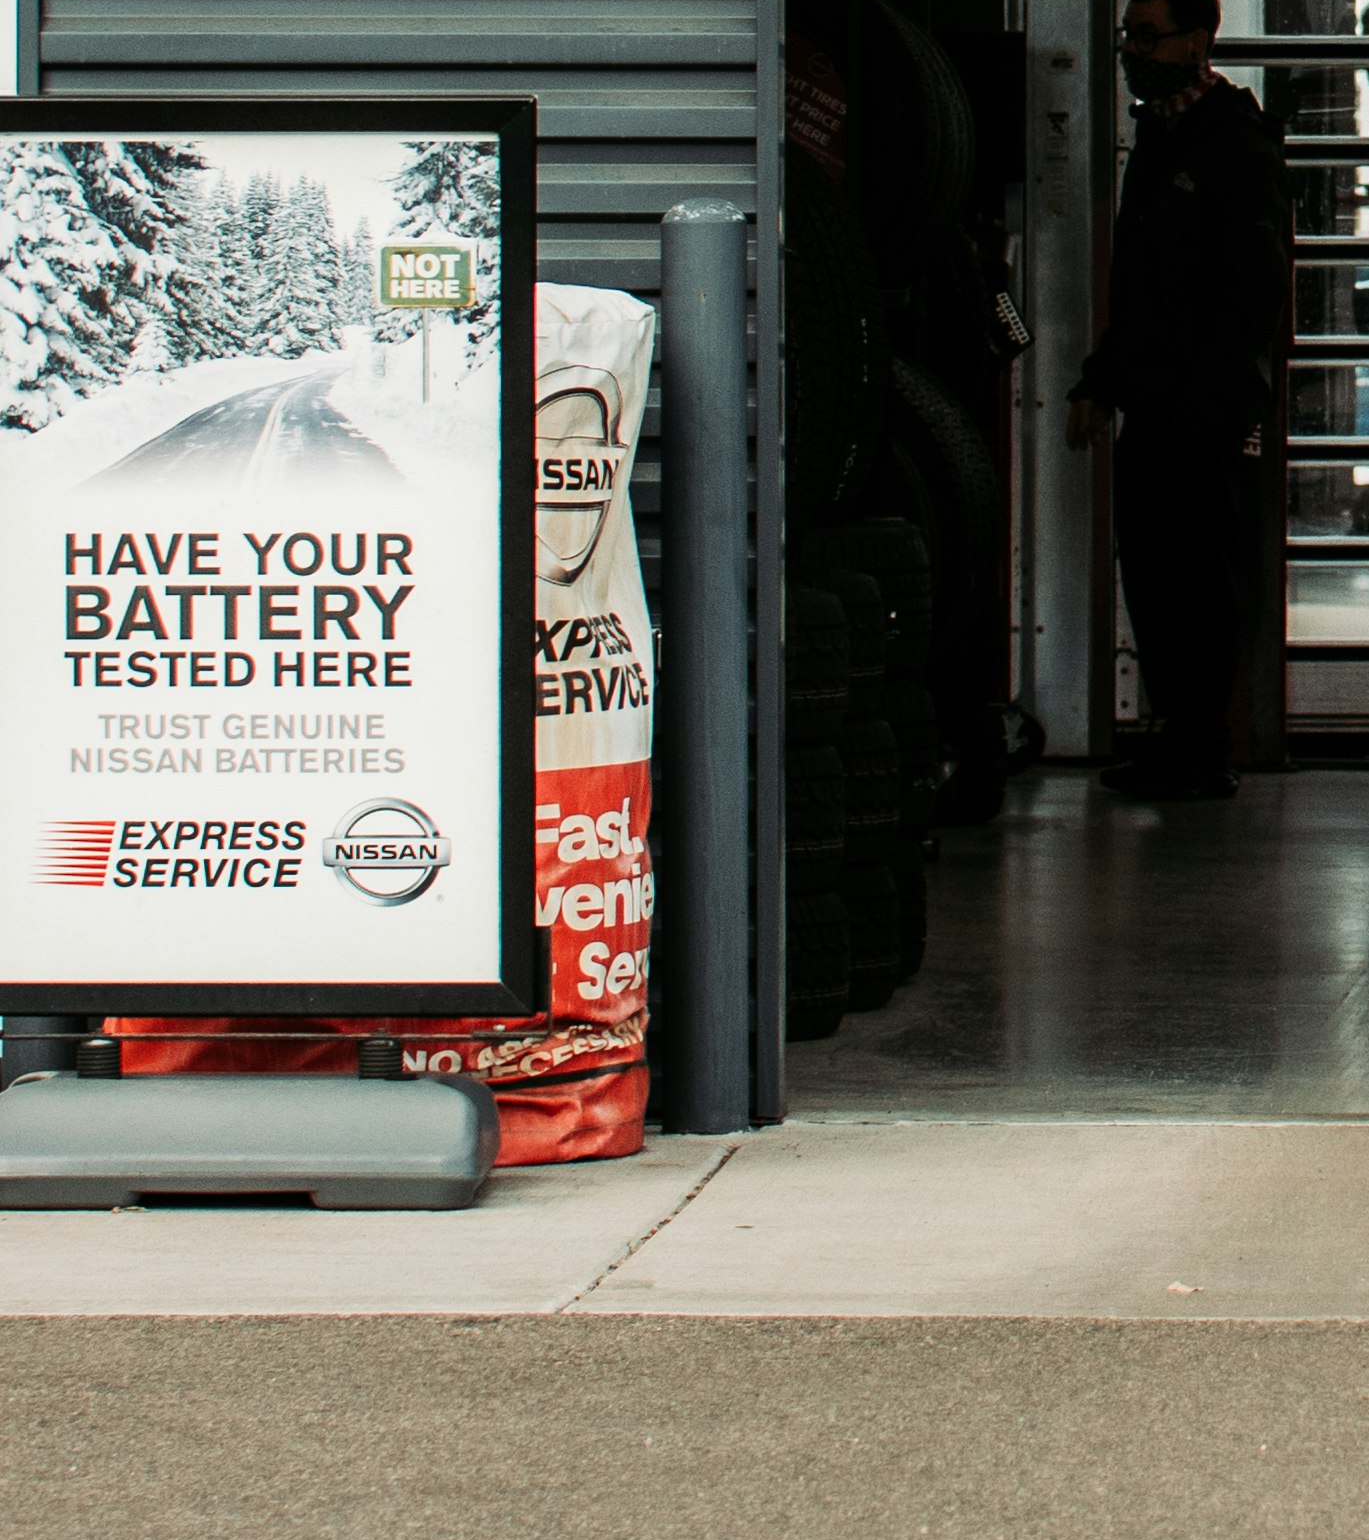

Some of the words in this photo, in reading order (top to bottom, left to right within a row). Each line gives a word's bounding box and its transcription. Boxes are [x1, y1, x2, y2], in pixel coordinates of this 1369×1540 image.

[390, 253, 461, 278] NOT
[390, 279, 461, 298] HERE
[65, 533, 221, 575] HAVE
[244, 533, 413, 576] YOUR
[65, 586, 414, 641] BATTERY
[64, 651, 257, 688] TESTED
[273, 650, 413, 688] HERE
[535, 663, 649, 715] ERVICE
[98, 714, 211, 740] TRUST
[222, 714, 386, 740] GENUINE
[69, 748, 200, 774] NISSAN
[215, 748, 406, 774] BATTERIES
[120, 820, 307, 852] EXPRESS
[334, 843, 438, 862] NISSAN
[113, 858, 302, 889] SERVICE
